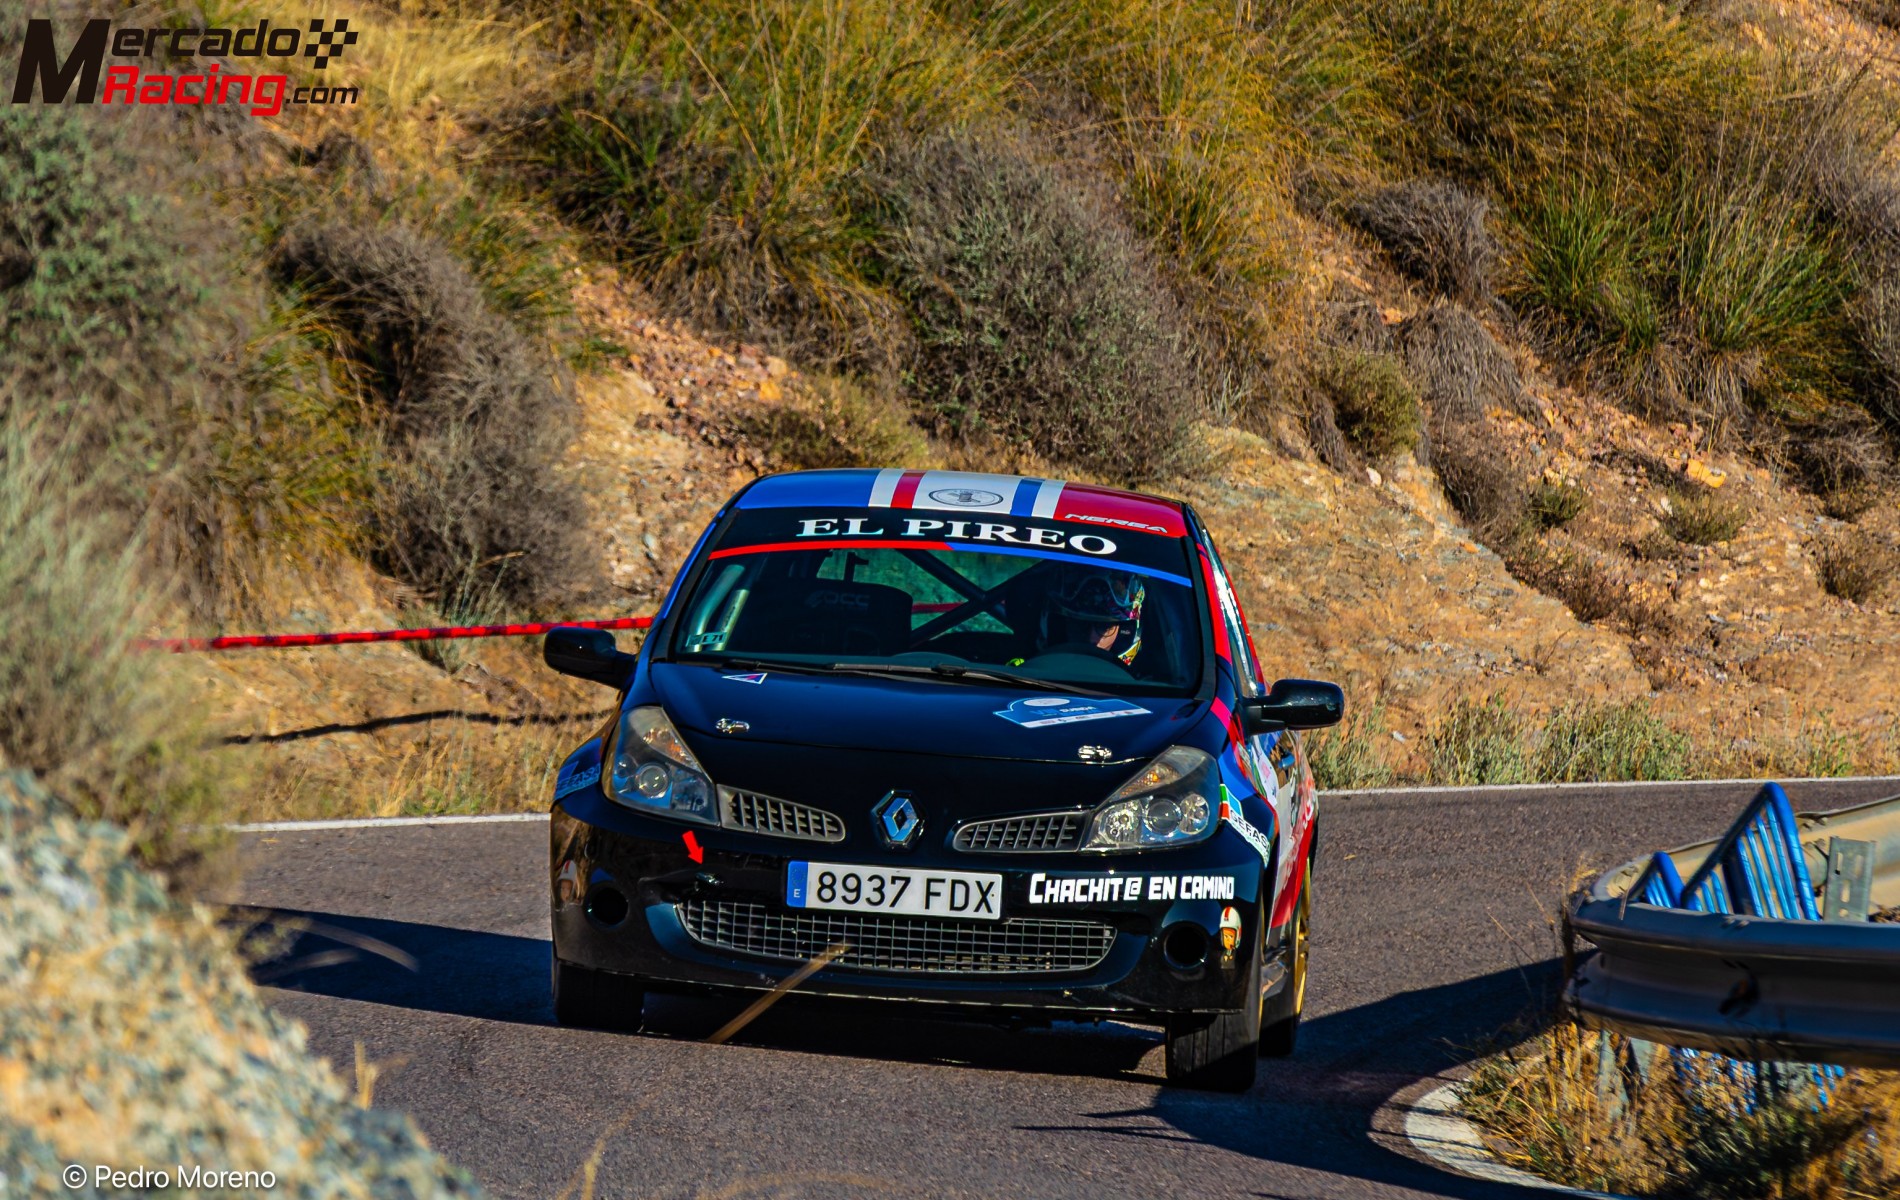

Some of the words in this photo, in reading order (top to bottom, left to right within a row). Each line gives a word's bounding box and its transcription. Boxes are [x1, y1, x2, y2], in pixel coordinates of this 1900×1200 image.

[796, 518, 884, 536] EL
[901, 518, 1117, 555] PIREO
[793, 888, 801, 898] E
[816, 871, 911, 908] 8937
[924, 877, 995, 914] FDX
[1148, 876, 1177, 900] EN
[1180, 875, 1235, 900] CAMINO
